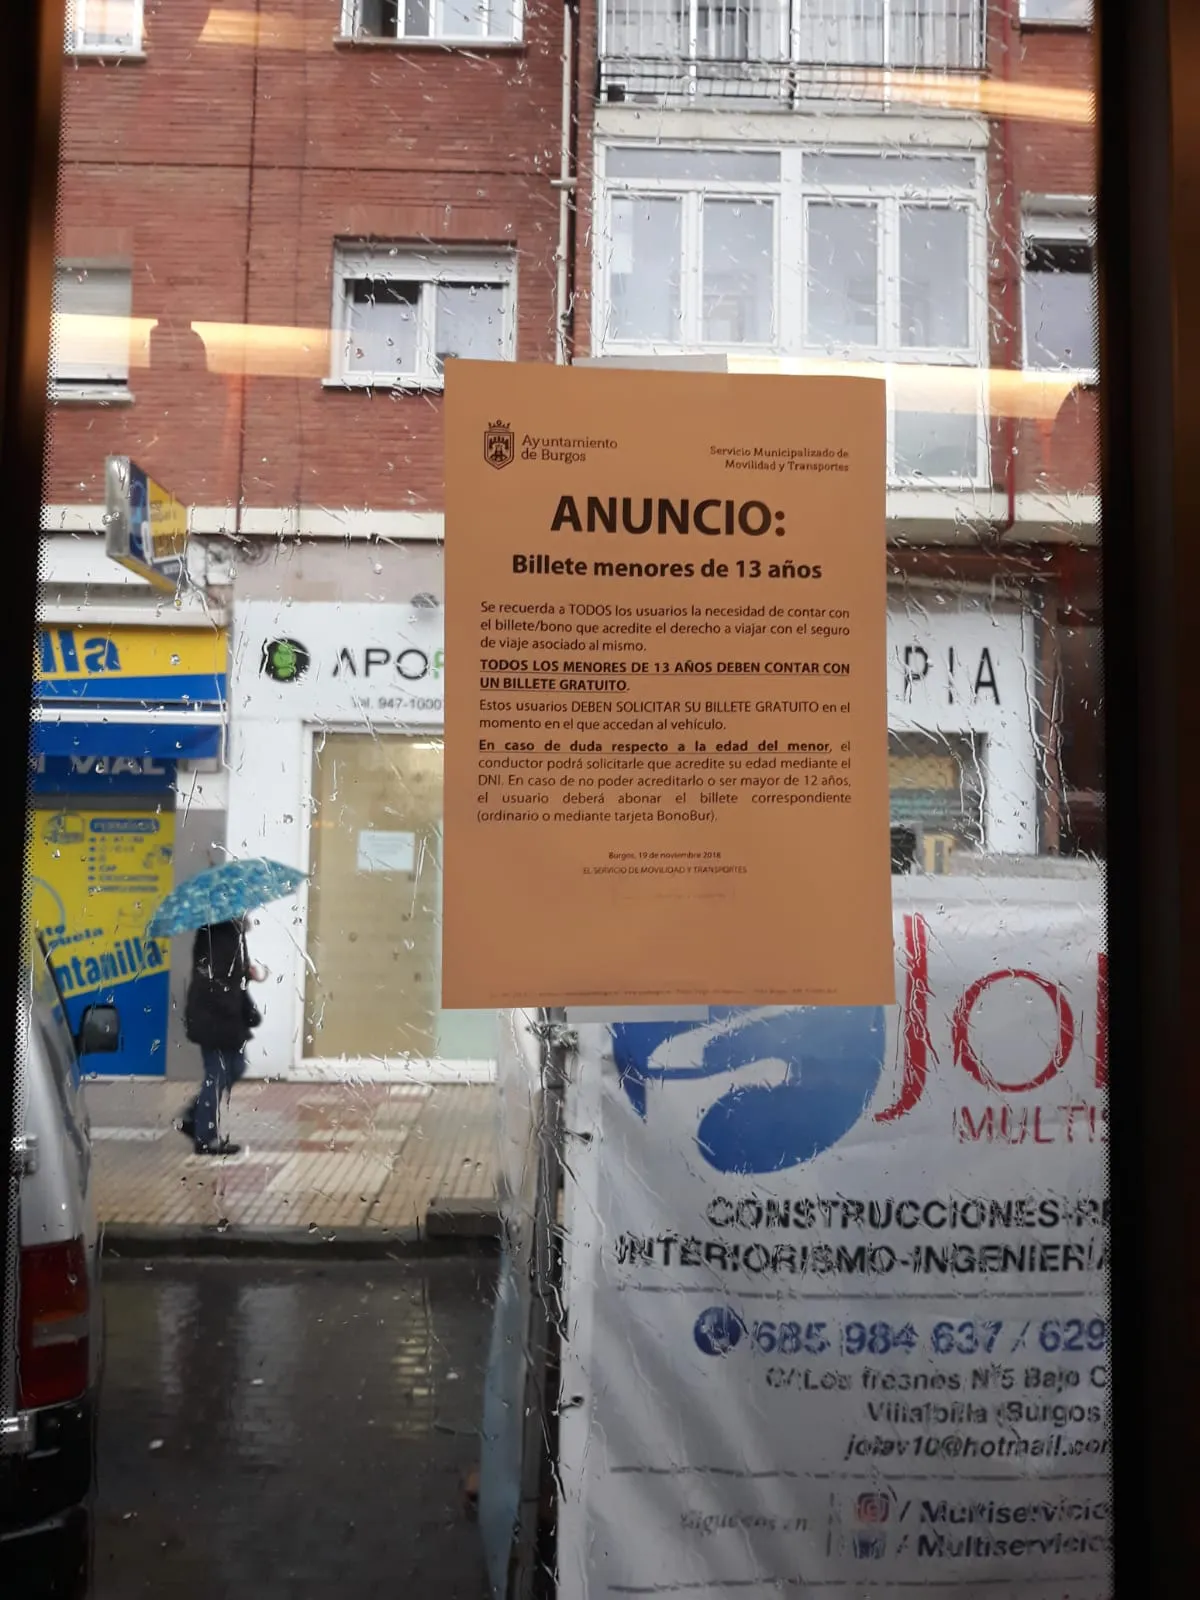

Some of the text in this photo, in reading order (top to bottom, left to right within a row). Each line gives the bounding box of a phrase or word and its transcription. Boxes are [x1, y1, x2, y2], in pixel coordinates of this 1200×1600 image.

[522, 434, 618, 451] Ayuntamiento
[521, 448, 586, 465] de Burgos
[710, 445, 849, 459] Servicio Municipalizado de
[725, 459, 849, 473] Movilidad y Transportes
[550, 495, 786, 537] ANUNCIO:
[513, 554, 822, 579] Billete menores de 13 años
[481, 601, 849, 618] Se recuerda a TODOS los usuarios la necesidad de contar con
[481, 620, 850, 637] el billete/bono que acredite el derecho a viajar con el seguro
[480, 637, 646, 651] de viaje asociado al mismo.
[480, 659, 850, 674] TODOS LOS MENORES DE 13 AÑOS DEBEN CONTAR CON
[480, 678, 630, 691] UN BILLETE GRATUITO.
[480, 699, 850, 713] Estos usuarios DEBEN SOLICITAR SU BILLETE GRATUITO en el
[479, 719, 726, 732] momento en el que accedan al vehículo.
[479, 740, 850, 754] En caso de duda respecto a la edad del menor, el
[478, 758, 851, 771] conductor podrá solicitarle que acredite su edad mediante el
[478, 774, 851, 789] DNI. En caso de no poder acreditarlo o ser mayor de 12 años,
[477, 792, 851, 805] el usuario deberá abonar el billete correspondiente
[477, 810, 717, 824] (ordinario o mediante tarjeta BonoBur).
[608, 852, 636, 861] Burgos,
[694, 866, 747, 874] TRANSPORTES
[957, 1104, 1109, 1146] MULTI
